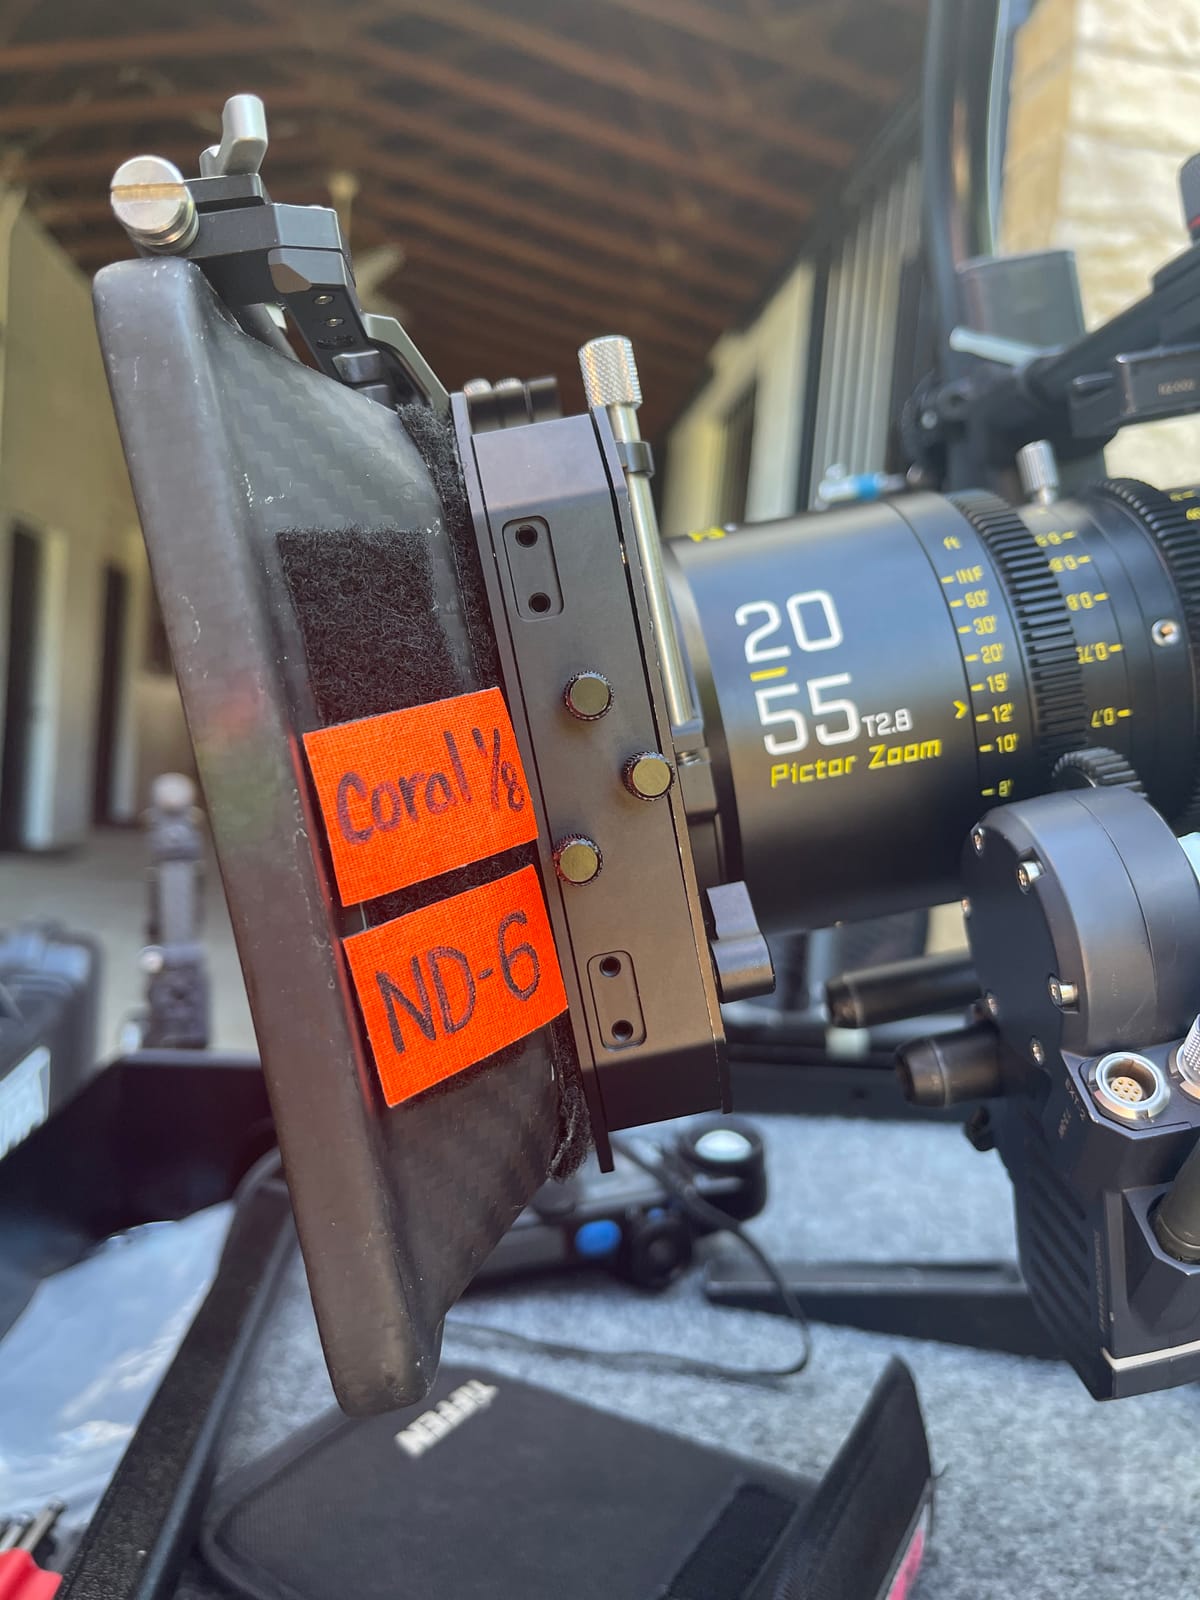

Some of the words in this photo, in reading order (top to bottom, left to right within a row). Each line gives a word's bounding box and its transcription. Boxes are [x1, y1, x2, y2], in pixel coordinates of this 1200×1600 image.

[955, 565, 983, 584] INF
[735, 589, 843, 663] 20
[755, 672, 861, 755] 55
[861, 708, 913, 737] T2.8
[336, 730, 472, 846] Coral
[771, 755, 856, 787] Pictor
[868, 739, 941, 769] Zoom
[375, 910, 541, 1055] ND-6
